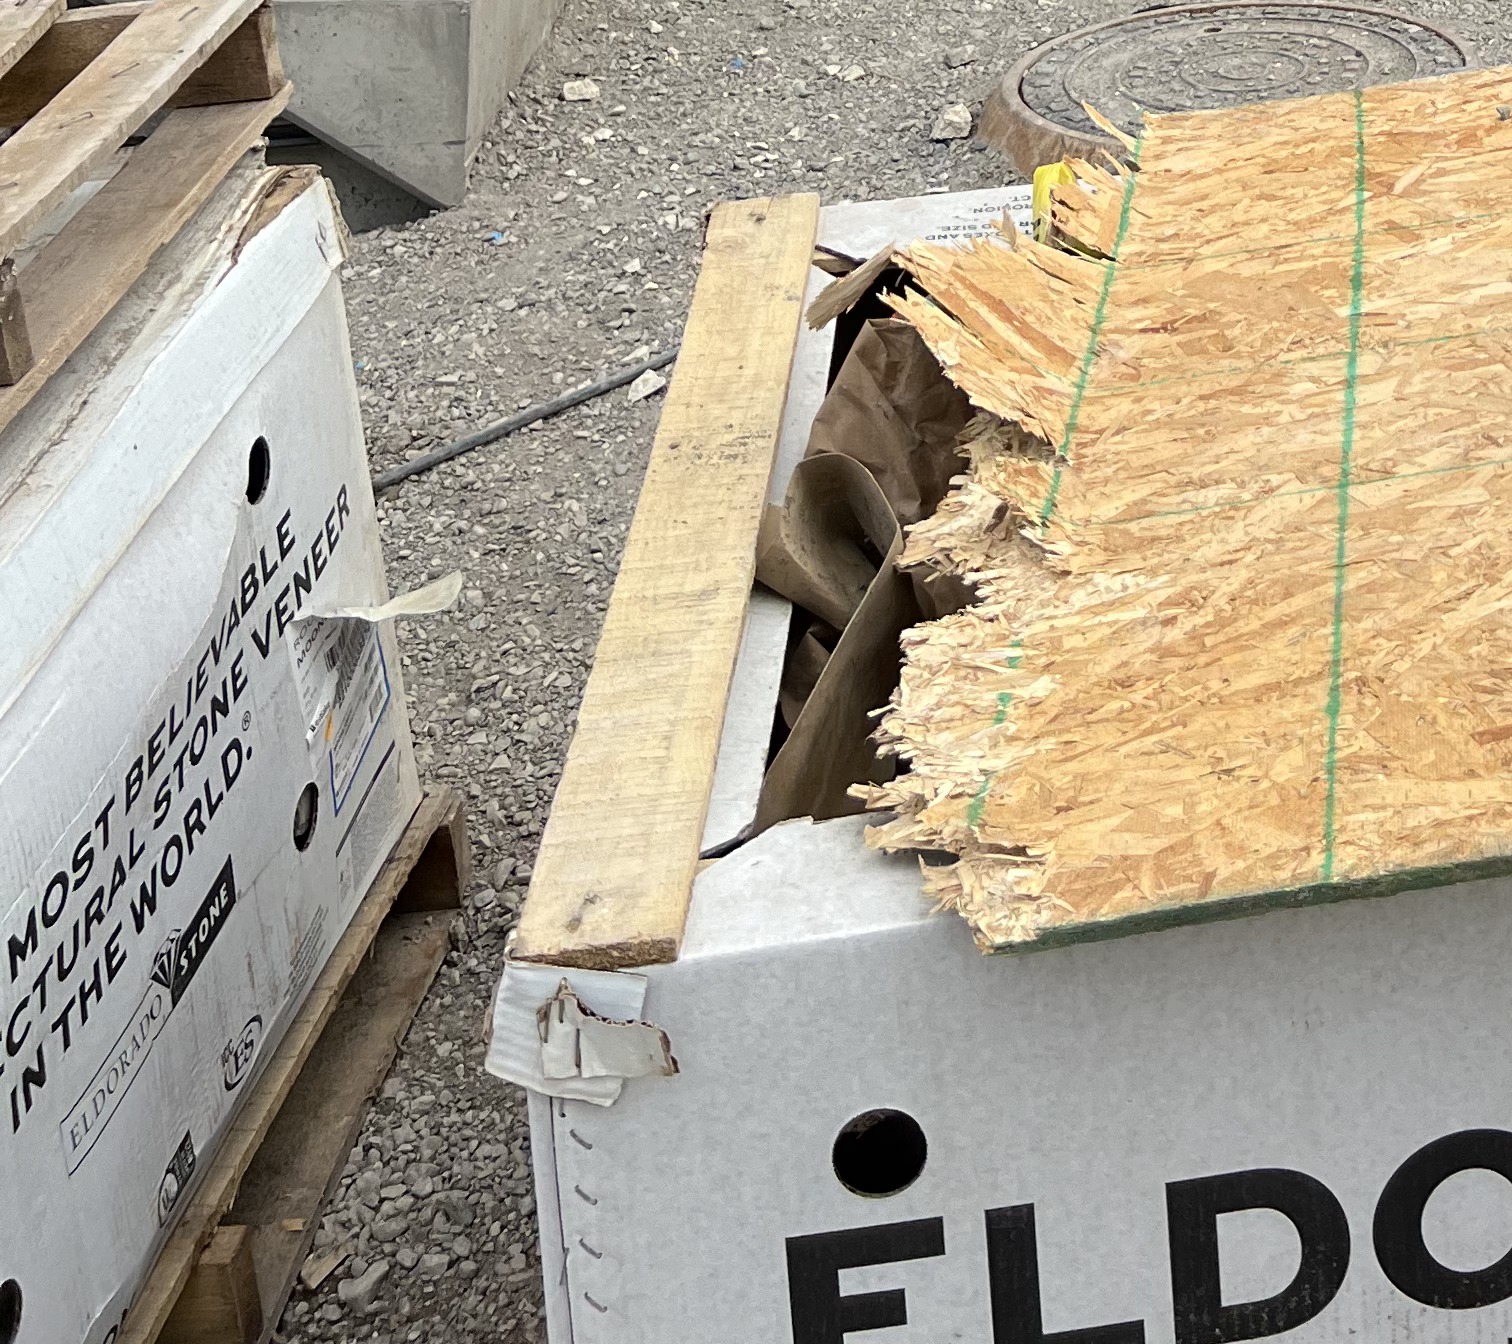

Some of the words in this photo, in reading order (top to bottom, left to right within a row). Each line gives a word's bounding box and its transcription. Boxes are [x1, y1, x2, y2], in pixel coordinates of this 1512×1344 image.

[0, 828, 145, 1073] CTURAL
[152, 648, 248, 830] STONE
[251, 483, 350, 659] VENEER
[8, 795, 116, 983] MOST
[125, 508, 296, 813] BELIEVABLE
[12, 1051, 47, 1134] IN
[51, 922, 128, 1053] THE
[68, 992, 162, 1152] ELDORADO
[179, 879, 230, 977] STONE
